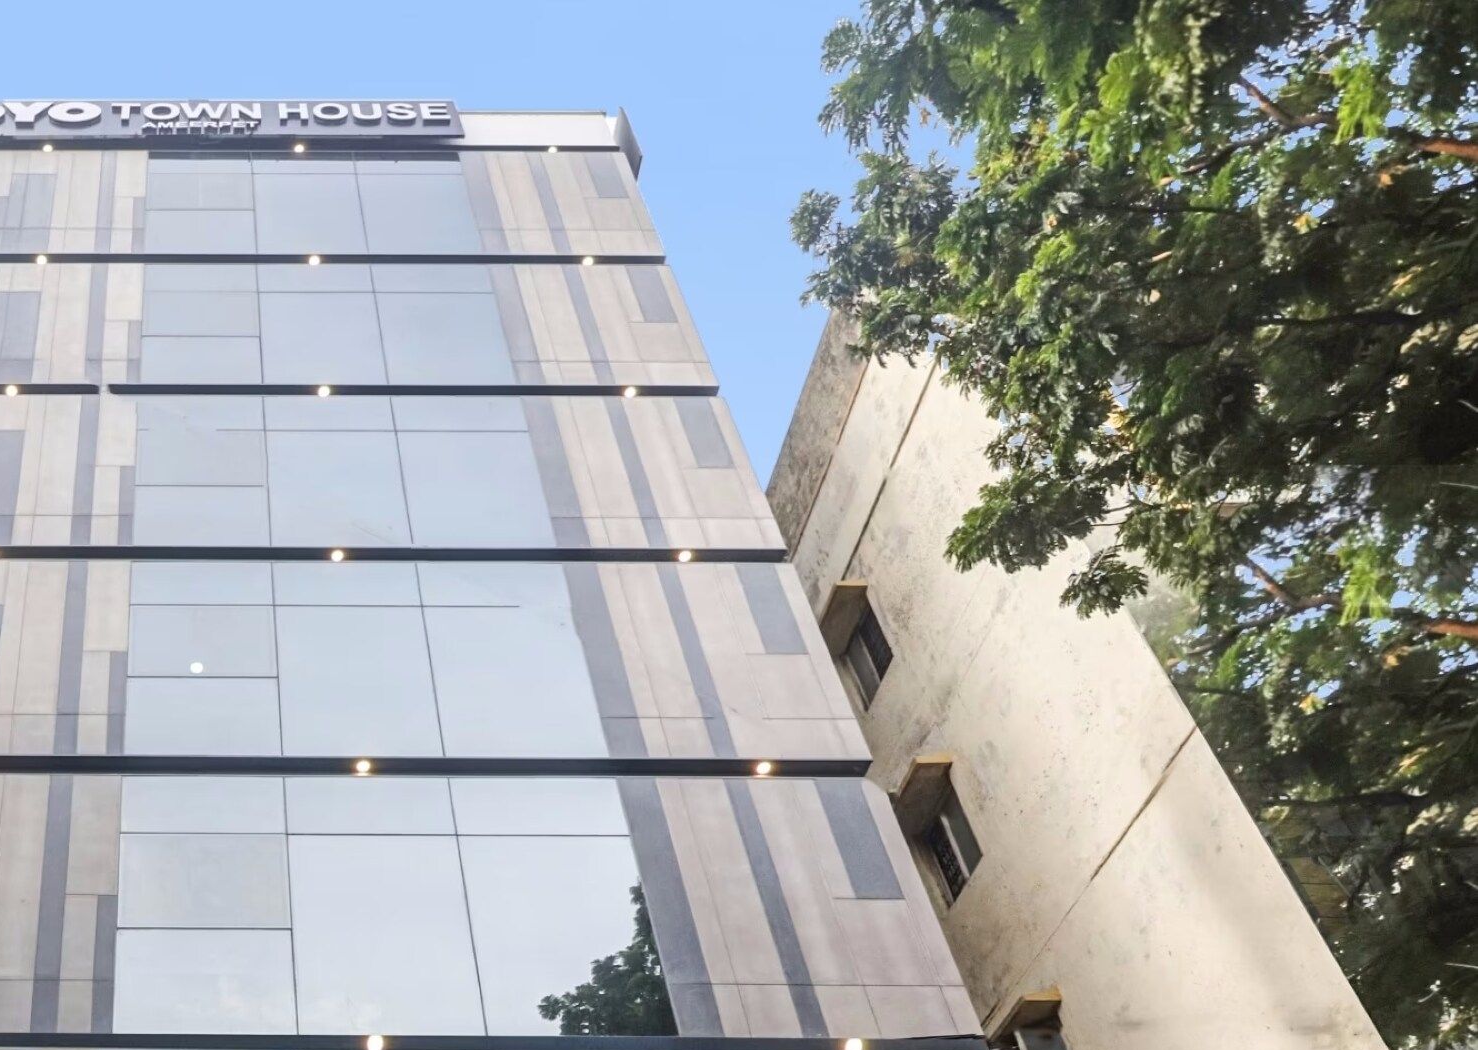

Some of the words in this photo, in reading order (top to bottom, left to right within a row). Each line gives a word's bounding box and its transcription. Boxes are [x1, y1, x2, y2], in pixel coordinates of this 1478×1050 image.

[111, 103, 262, 124] TOWN
[278, 103, 451, 124] HOUSE
[141, 121, 260, 130] AMEERPET
